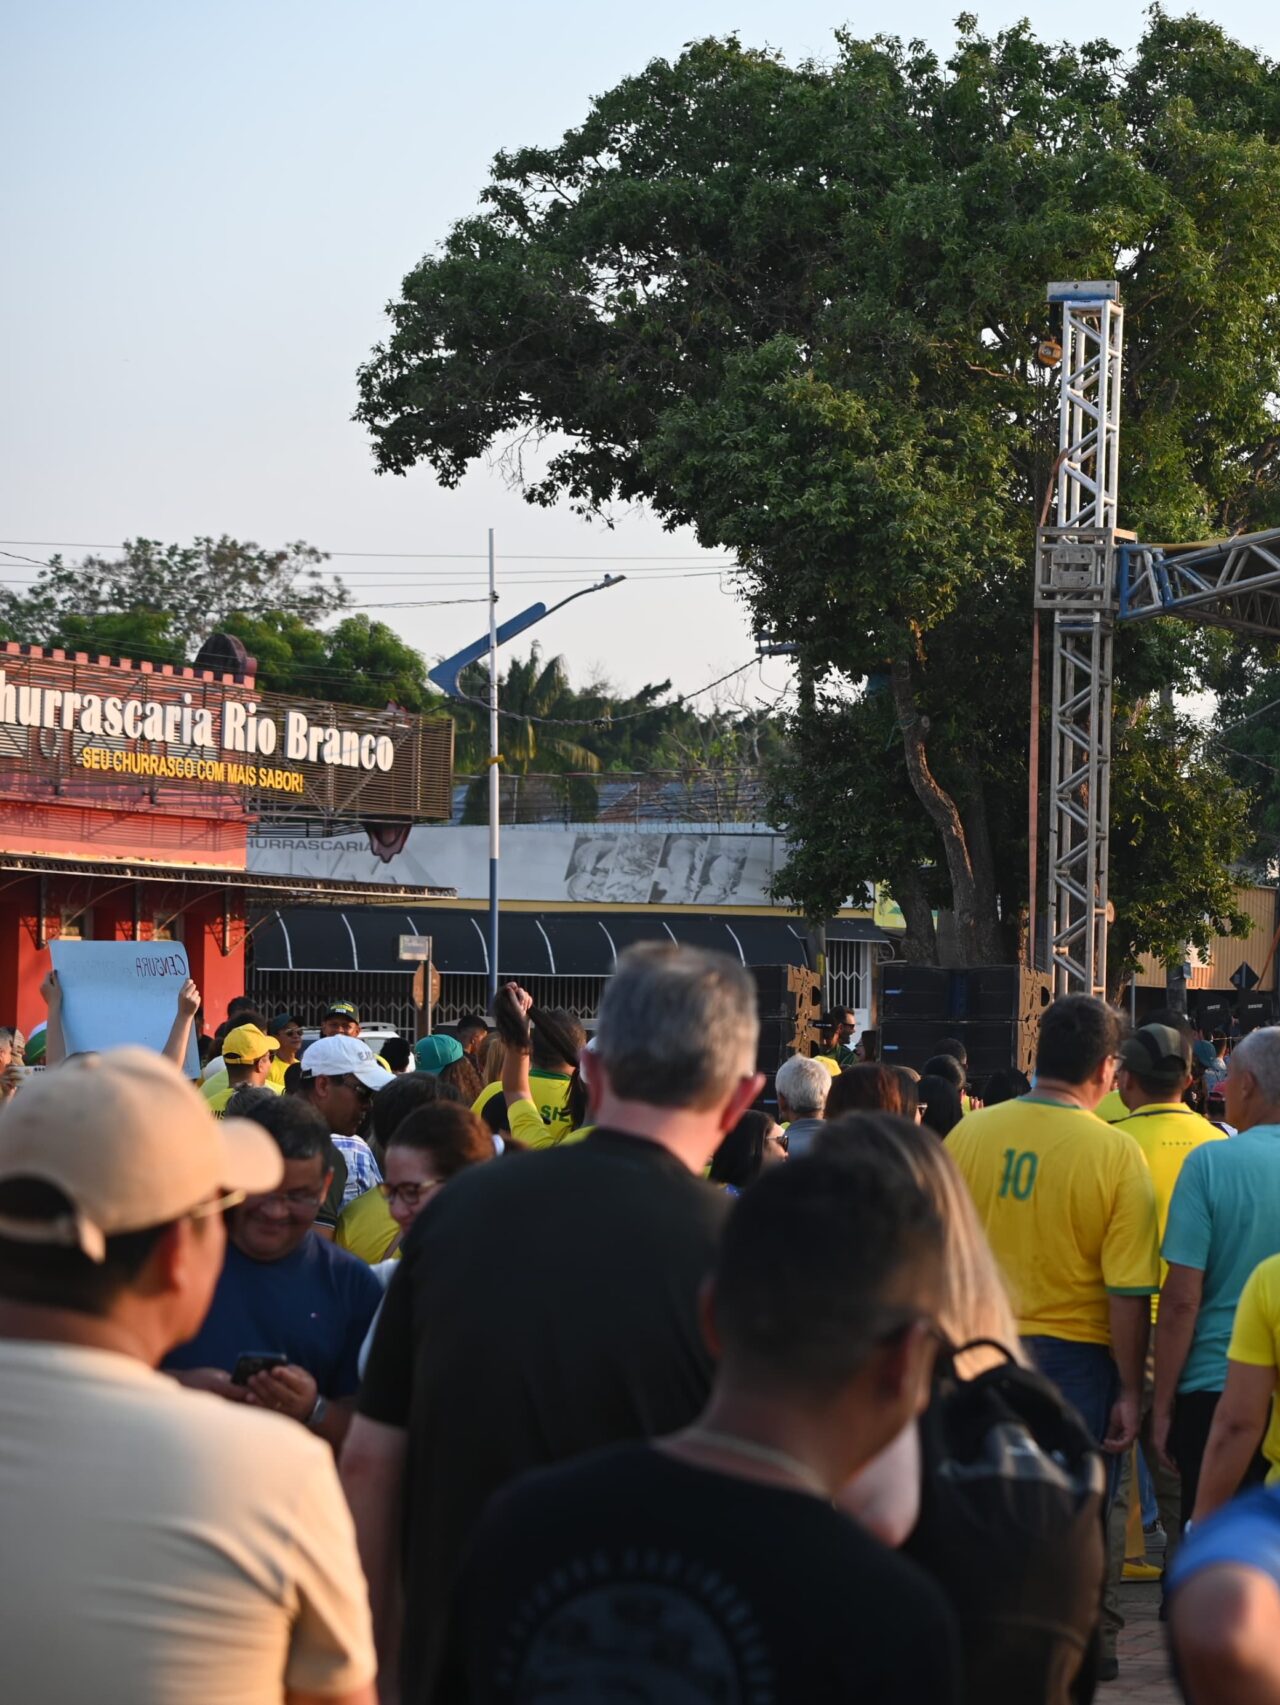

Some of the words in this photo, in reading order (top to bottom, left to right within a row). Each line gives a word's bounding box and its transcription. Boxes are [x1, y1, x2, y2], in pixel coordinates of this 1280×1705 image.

[223, 700, 276, 755] Rio
[286, 711, 394, 772] Branco
[82, 747, 110, 769] SEU
[113, 751, 193, 778] CHURRASCO
[197, 760, 224, 782] COM
[227, 763, 256, 786] MAIS
[259, 768, 304, 793] SABOR!
[998, 1148, 1038, 1201] 10
